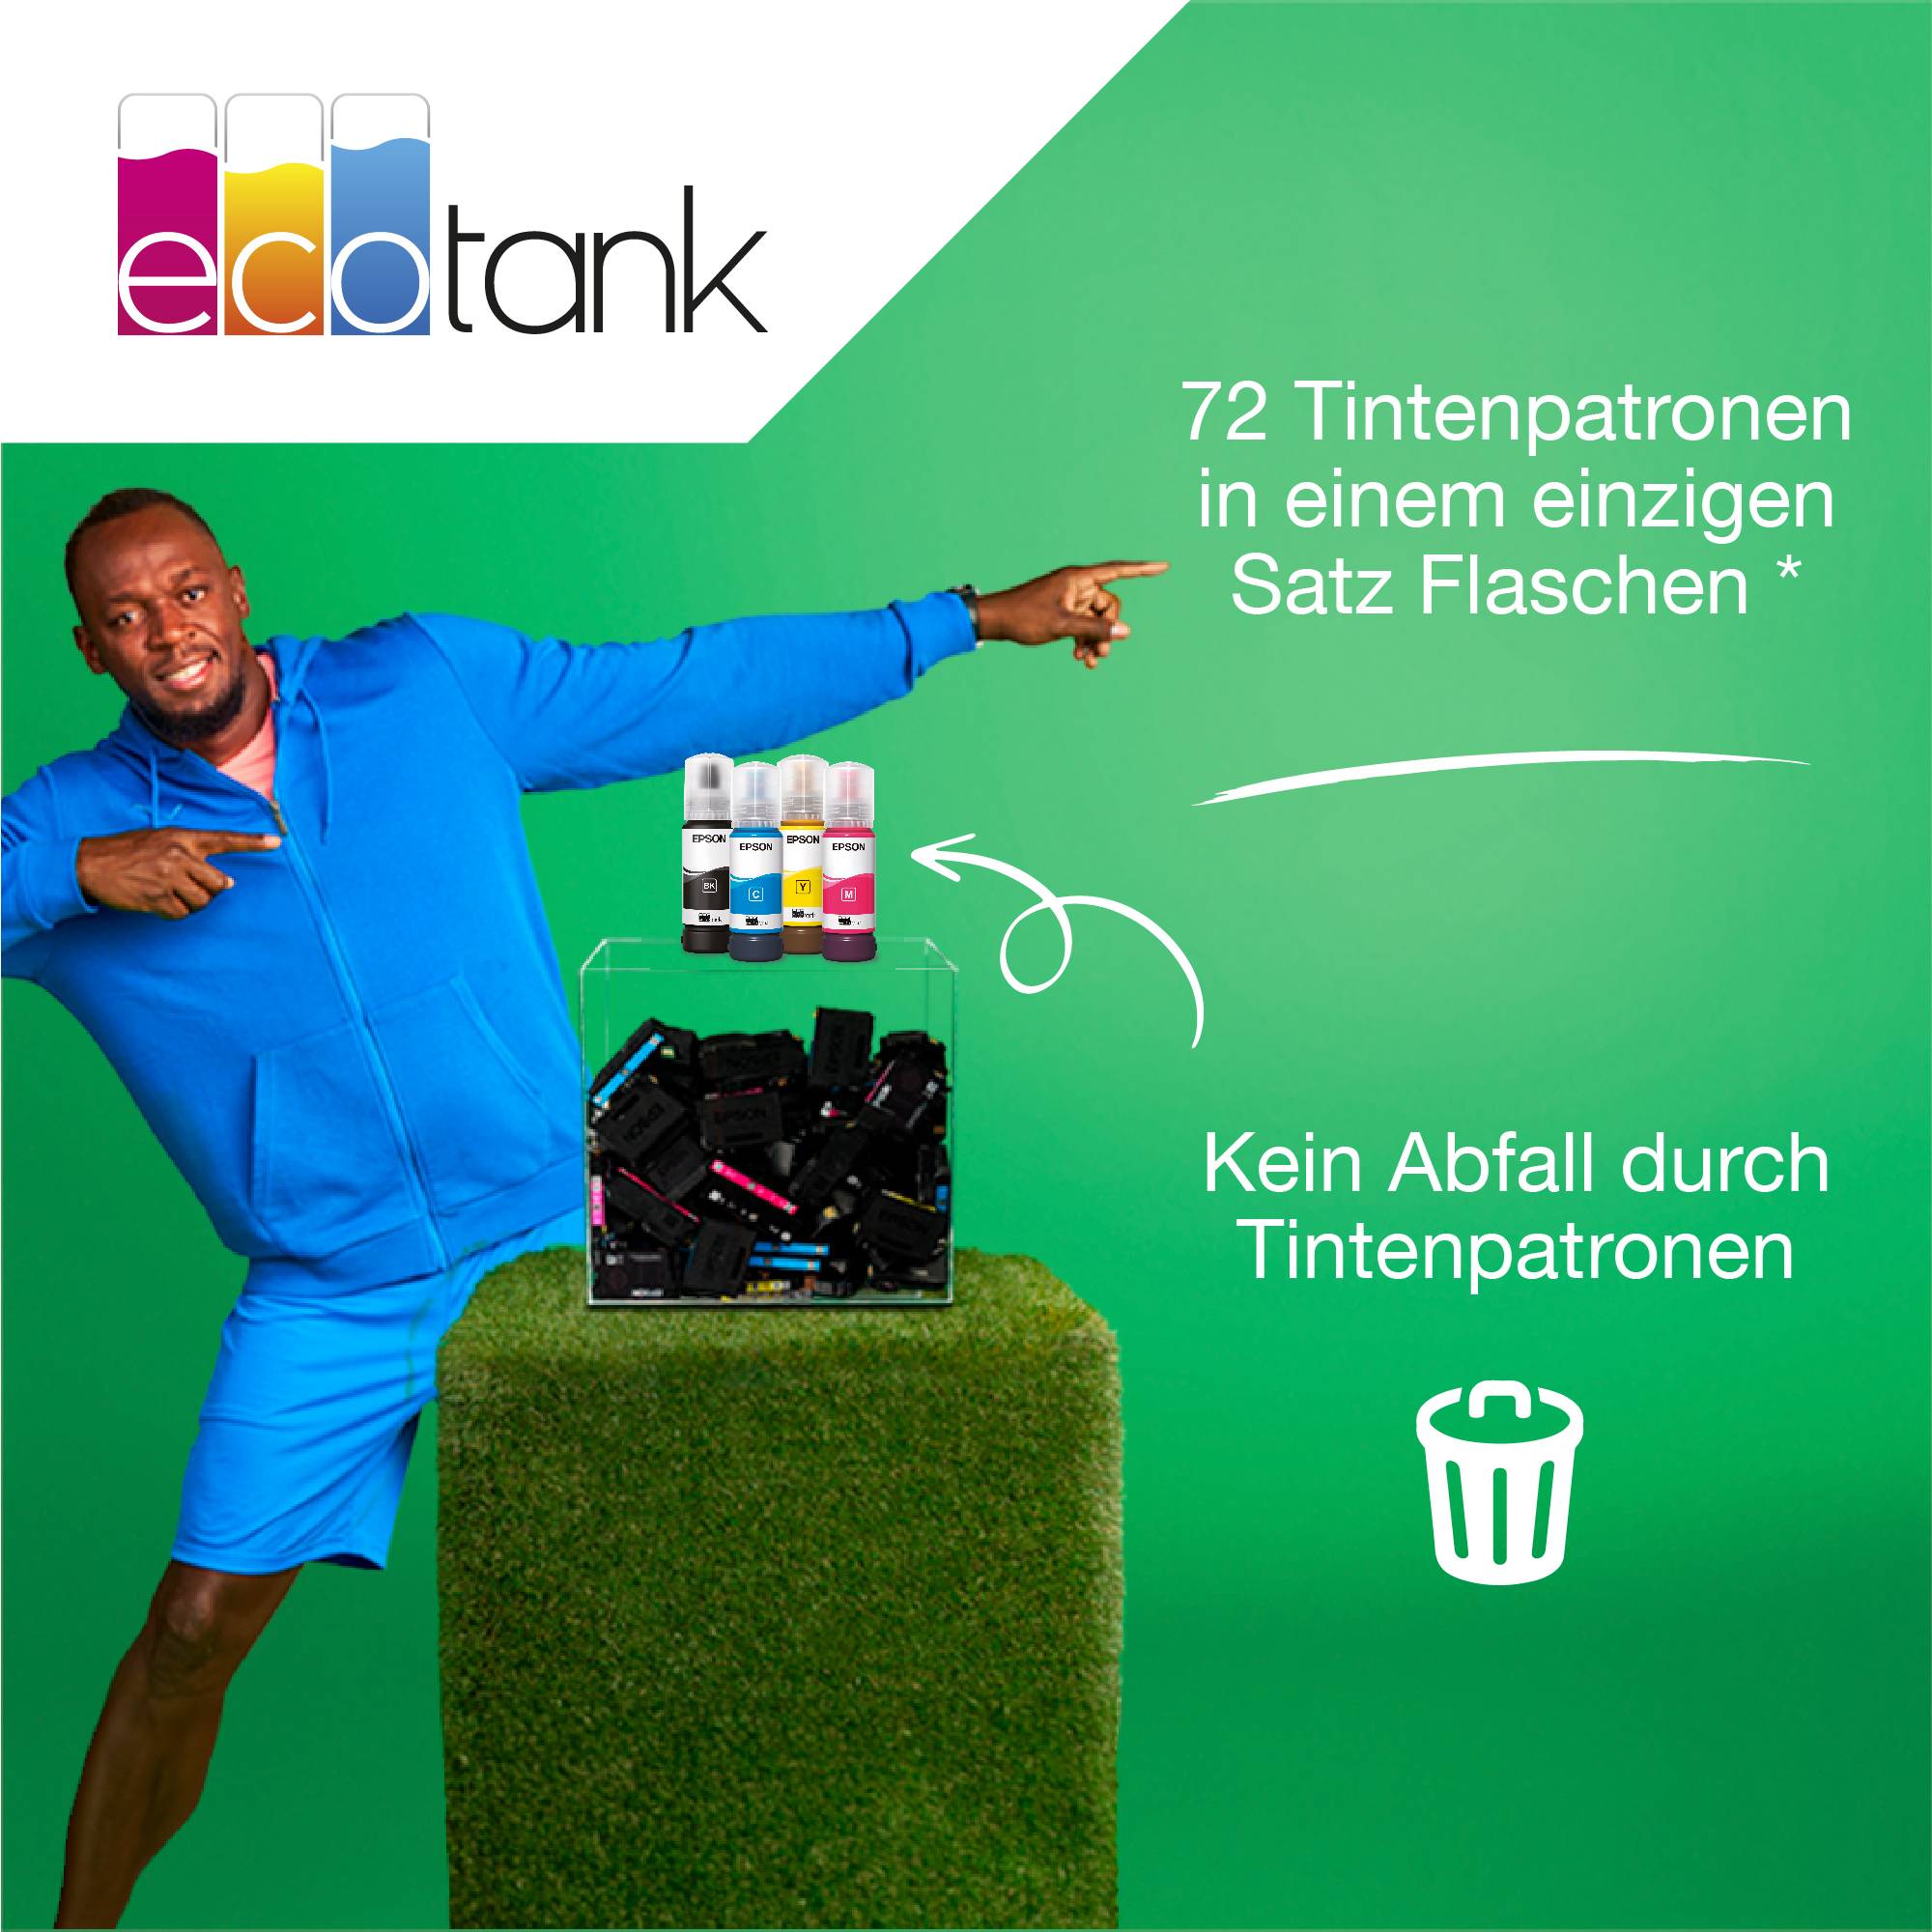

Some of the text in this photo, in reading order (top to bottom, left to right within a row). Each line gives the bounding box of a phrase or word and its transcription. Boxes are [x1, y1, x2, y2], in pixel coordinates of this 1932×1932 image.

[692, 834, 726, 843] EPSON
[787, 835, 820, 844] EPSON
[739, 842, 773, 851] EPSON
[832, 842, 866, 851] EPSON
